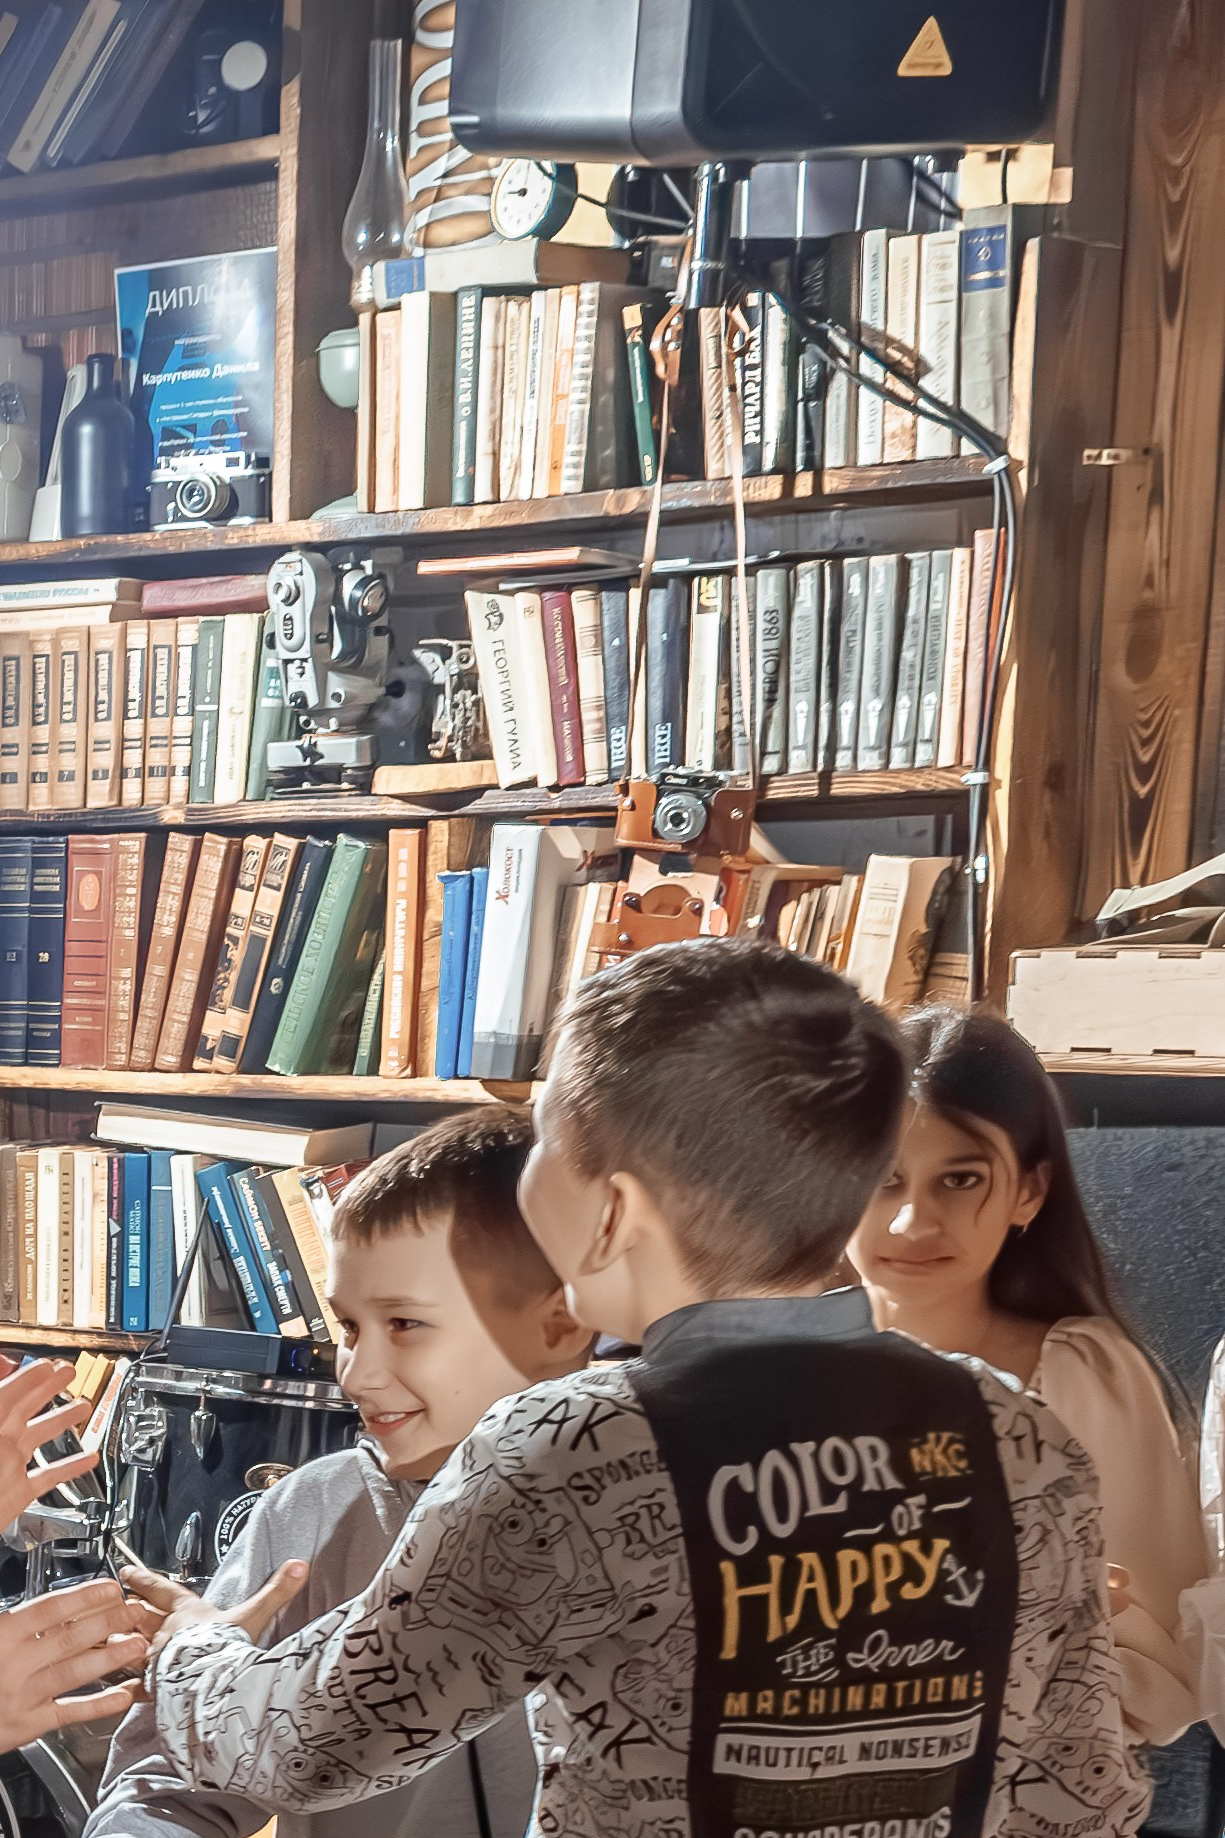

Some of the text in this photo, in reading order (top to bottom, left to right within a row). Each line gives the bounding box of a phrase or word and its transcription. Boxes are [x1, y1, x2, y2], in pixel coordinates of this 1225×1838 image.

[762, 608, 780, 642] 1863
[491, 639, 523, 772] ГЕОРГИЙ ГУЛИА
[707, 1435, 906, 1556] COLOR
[891, 1493, 928, 1536] OF
[219, 1515, 236, 1540] 100%
[719, 1538, 951, 1660] HAPPY
[776, 1638, 837, 1676] THE
[724, 1741, 849, 1777] NAUTICAL
